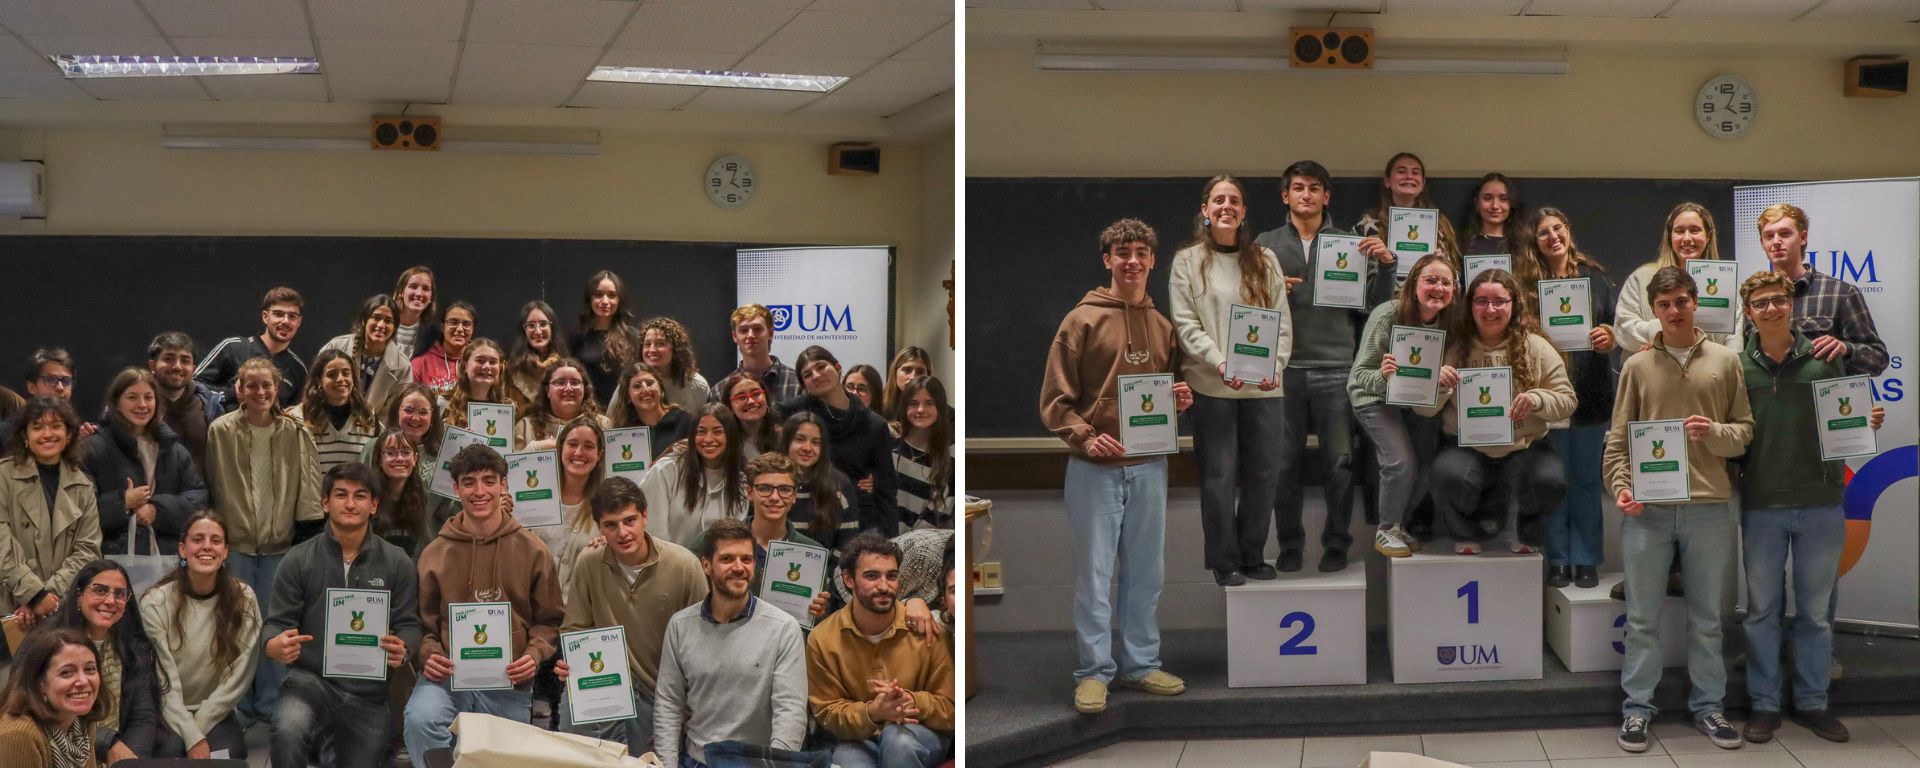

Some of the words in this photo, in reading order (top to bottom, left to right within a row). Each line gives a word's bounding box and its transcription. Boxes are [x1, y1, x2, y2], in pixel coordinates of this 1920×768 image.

[1720, 84, 1735, 94] 12
[1703, 103, 1714, 113] 9
[1740, 103, 1751, 112] 3
[1722, 122, 1733, 131] 6
[712, 178, 721, 187] 9
[742, 178, 751, 187] 3
[727, 194, 737, 203] 6
[796, 304, 856, 331] UM
[1891, 356, 1902, 369] S
[1457, 581, 1479, 624] 1
[1280, 612, 1317, 655] 2
[569, 643, 580, 652] UM
[1460, 645, 1500, 665] UM
